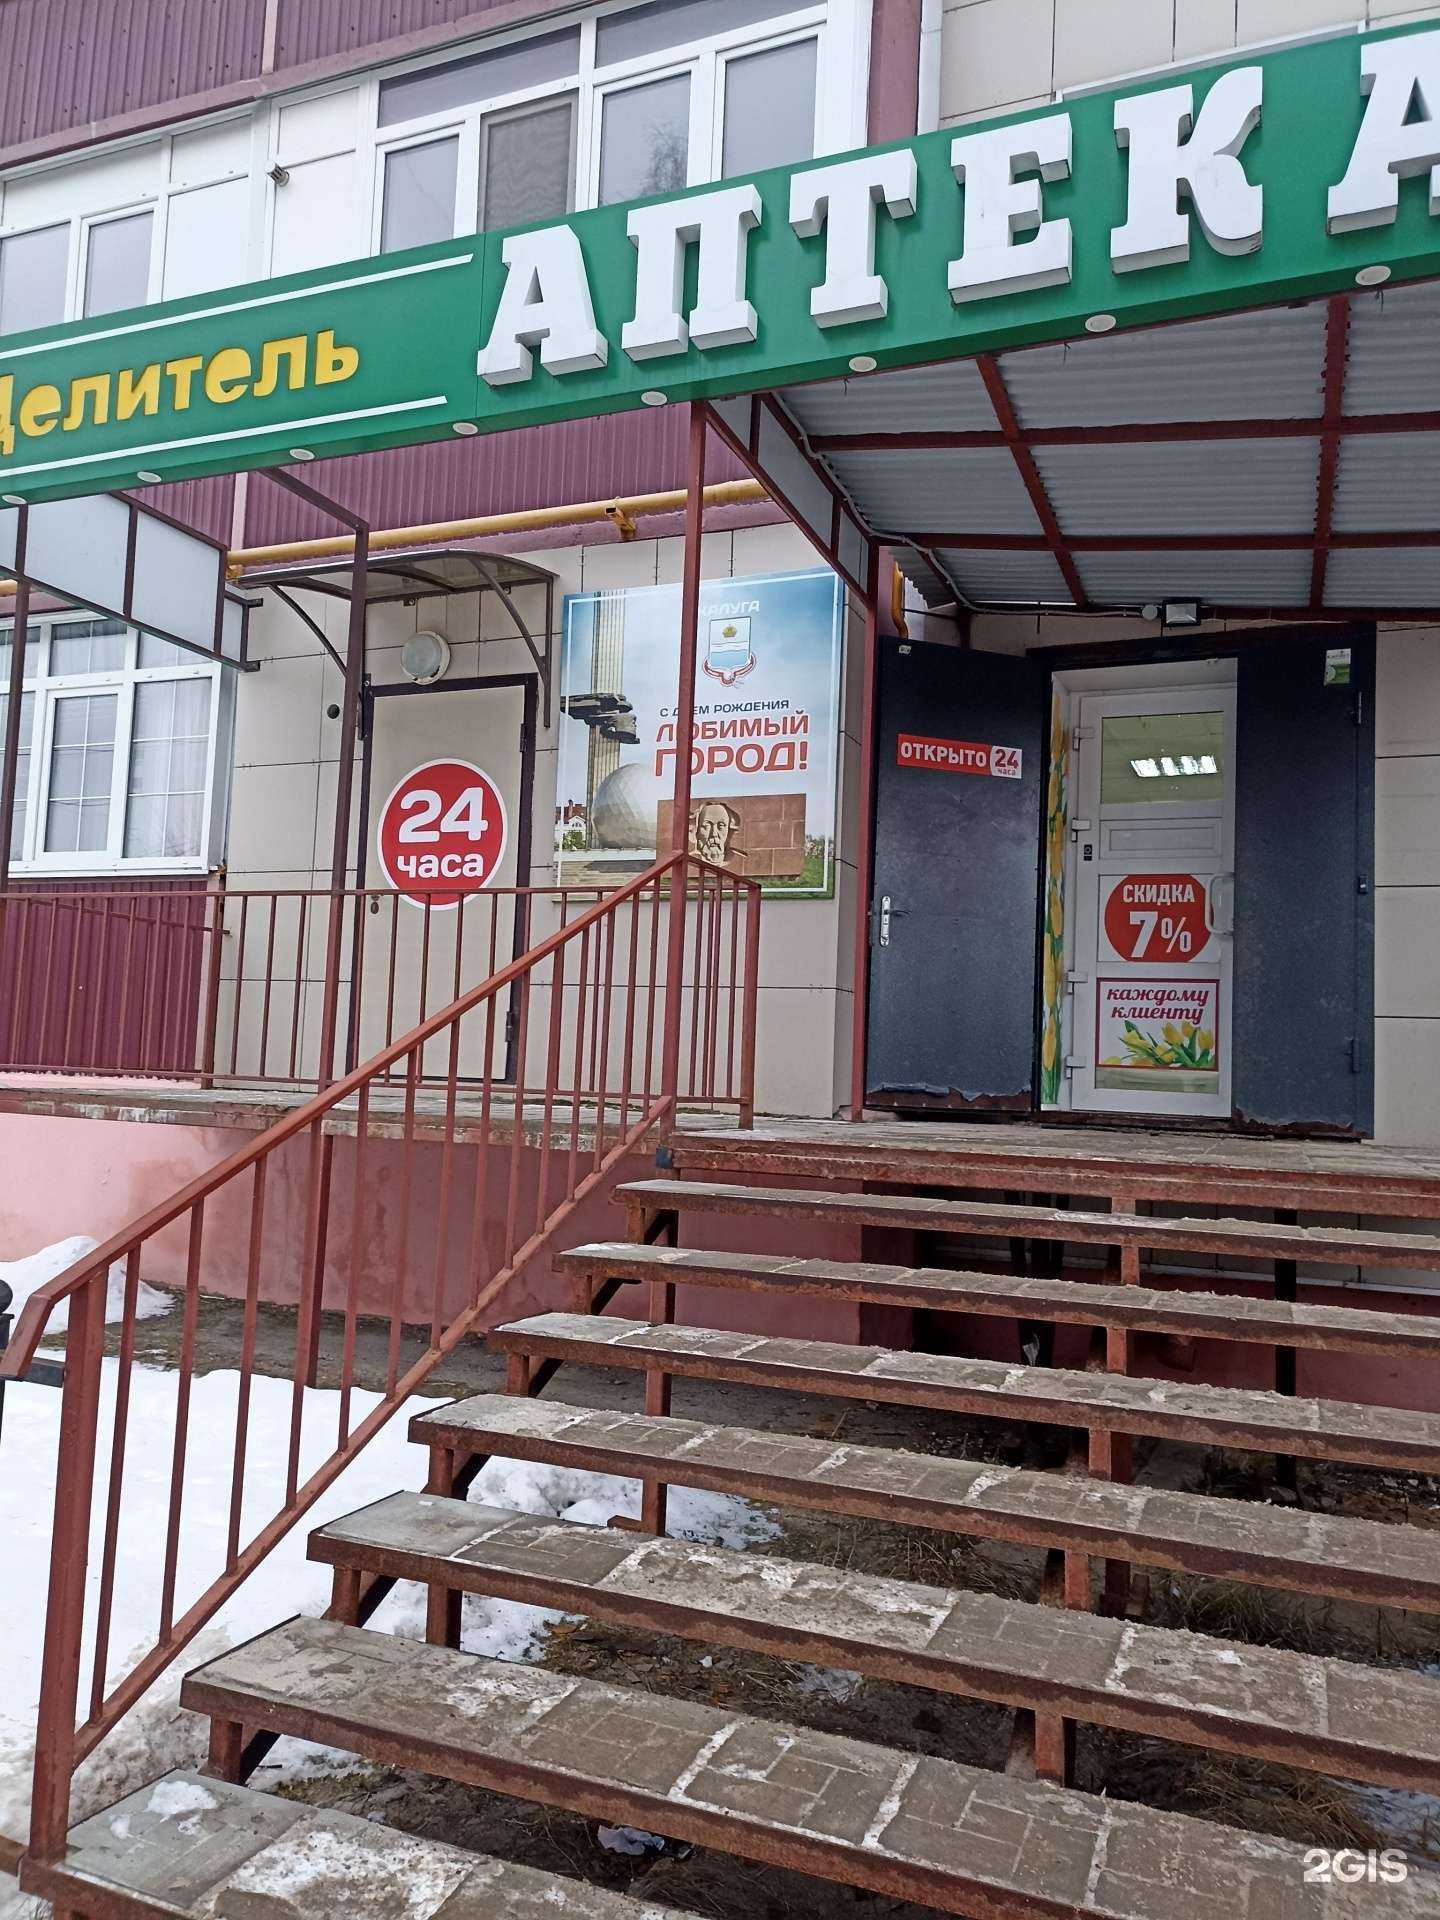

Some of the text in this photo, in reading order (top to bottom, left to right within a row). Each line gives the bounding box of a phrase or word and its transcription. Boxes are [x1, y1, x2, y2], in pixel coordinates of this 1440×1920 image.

[476, 28, 1440, 386] АПТЕКА
[659, 700, 789, 717] С ДЕМ РОЖДЕНИЯ
[900, 742, 1019, 769] ОТКРЫТО 24
[997, 767, 1016, 776] часа
[398, 787, 489, 843] 24
[397, 853, 484, 878] часа
[1122, 884, 1195, 906] СКИДКА
[1129, 910, 1192, 958] 7%
[1106, 988, 1209, 1007] каждому
[1111, 1006, 1204, 1025] клиенту
